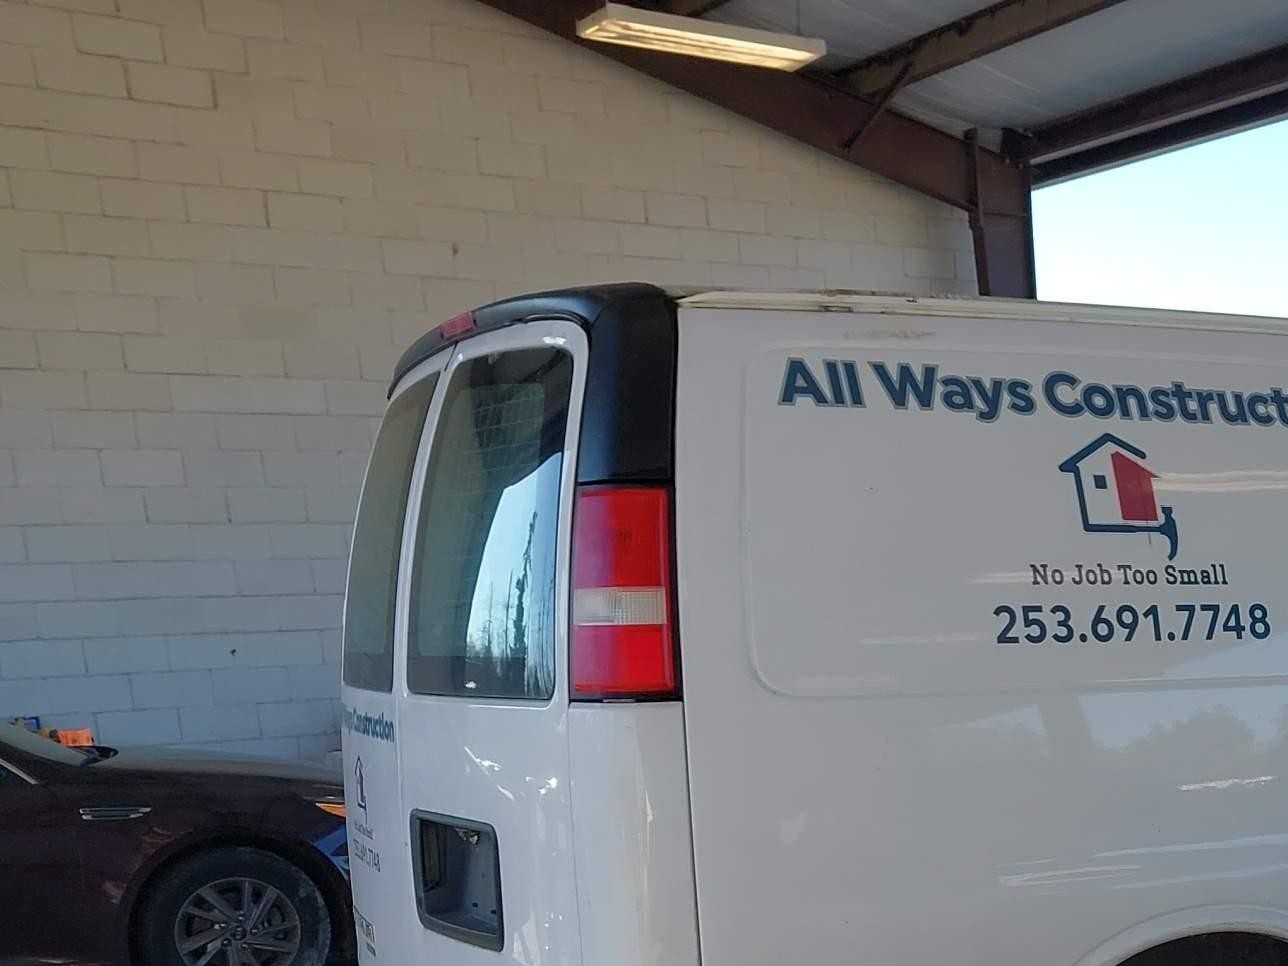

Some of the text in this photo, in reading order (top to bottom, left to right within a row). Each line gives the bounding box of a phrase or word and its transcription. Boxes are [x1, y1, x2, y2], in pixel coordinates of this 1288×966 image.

[777, 356, 866, 408] All
[868, 361, 1036, 423] Ways
[1030, 564, 1229, 586] No Job Too Small
[993, 603, 1272, 644] 253.691.7748
